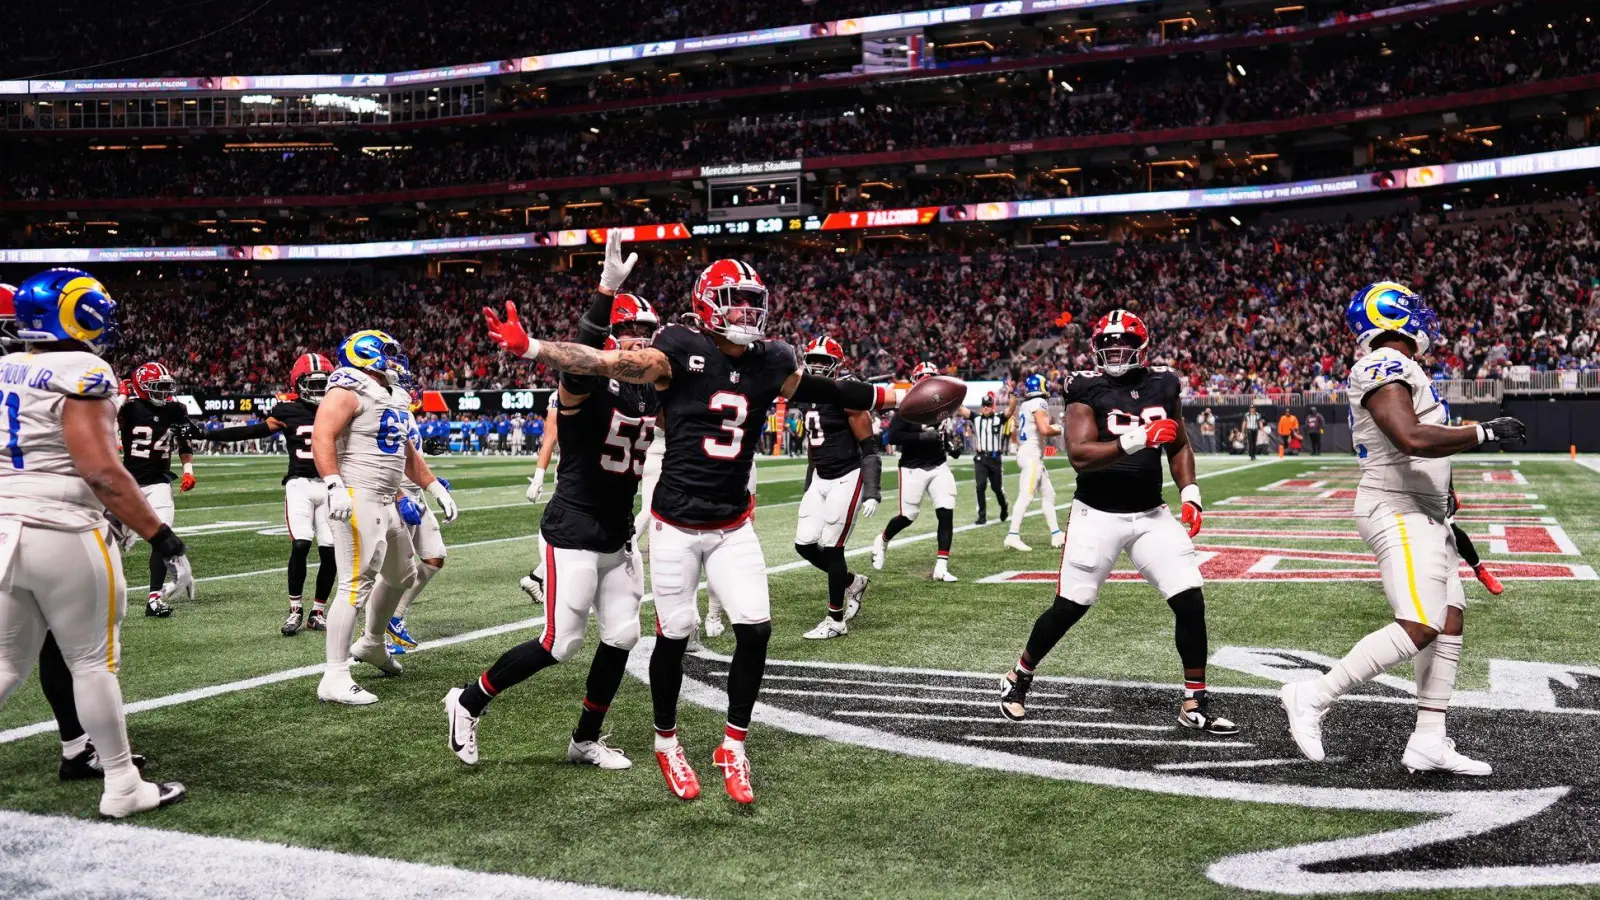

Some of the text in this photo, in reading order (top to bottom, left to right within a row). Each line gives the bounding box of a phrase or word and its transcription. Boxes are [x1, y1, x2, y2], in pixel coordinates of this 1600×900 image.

[701, 163, 763, 176] Mercedes-Benz
[764, 161, 801, 172] Stadium
[1457, 161, 1496, 180] ATLANTA
[1202, 180, 1357, 202] PROUD PARTNER OF THE ATLANTA FALCONS
[757, 218, 783, 232] 8:30
[790, 219, 801, 230] 25
[850, 209, 918, 226] 7 FALCONS
[715, 224, 721, 233] 3
[437, 241, 459, 249] PARTNER
[479, 239, 500, 247] ATLANTA
[501, 237, 525, 245] FALCONS
[689, 355, 704, 369] C
[330, 372, 358, 384] 67
[1364, 361, 1403, 380] 72
[28, 367, 53, 390] JR
[205, 399, 221, 411] 3RD
[229, 399, 235, 410] 3
[240, 399, 252, 411] 25
[458, 397, 480, 410] 2ND
[502, 391, 534, 409] 8:30
[0, 389, 24, 469] 1
[703, 390, 749, 460] 3
[130, 425, 174, 459] 24
